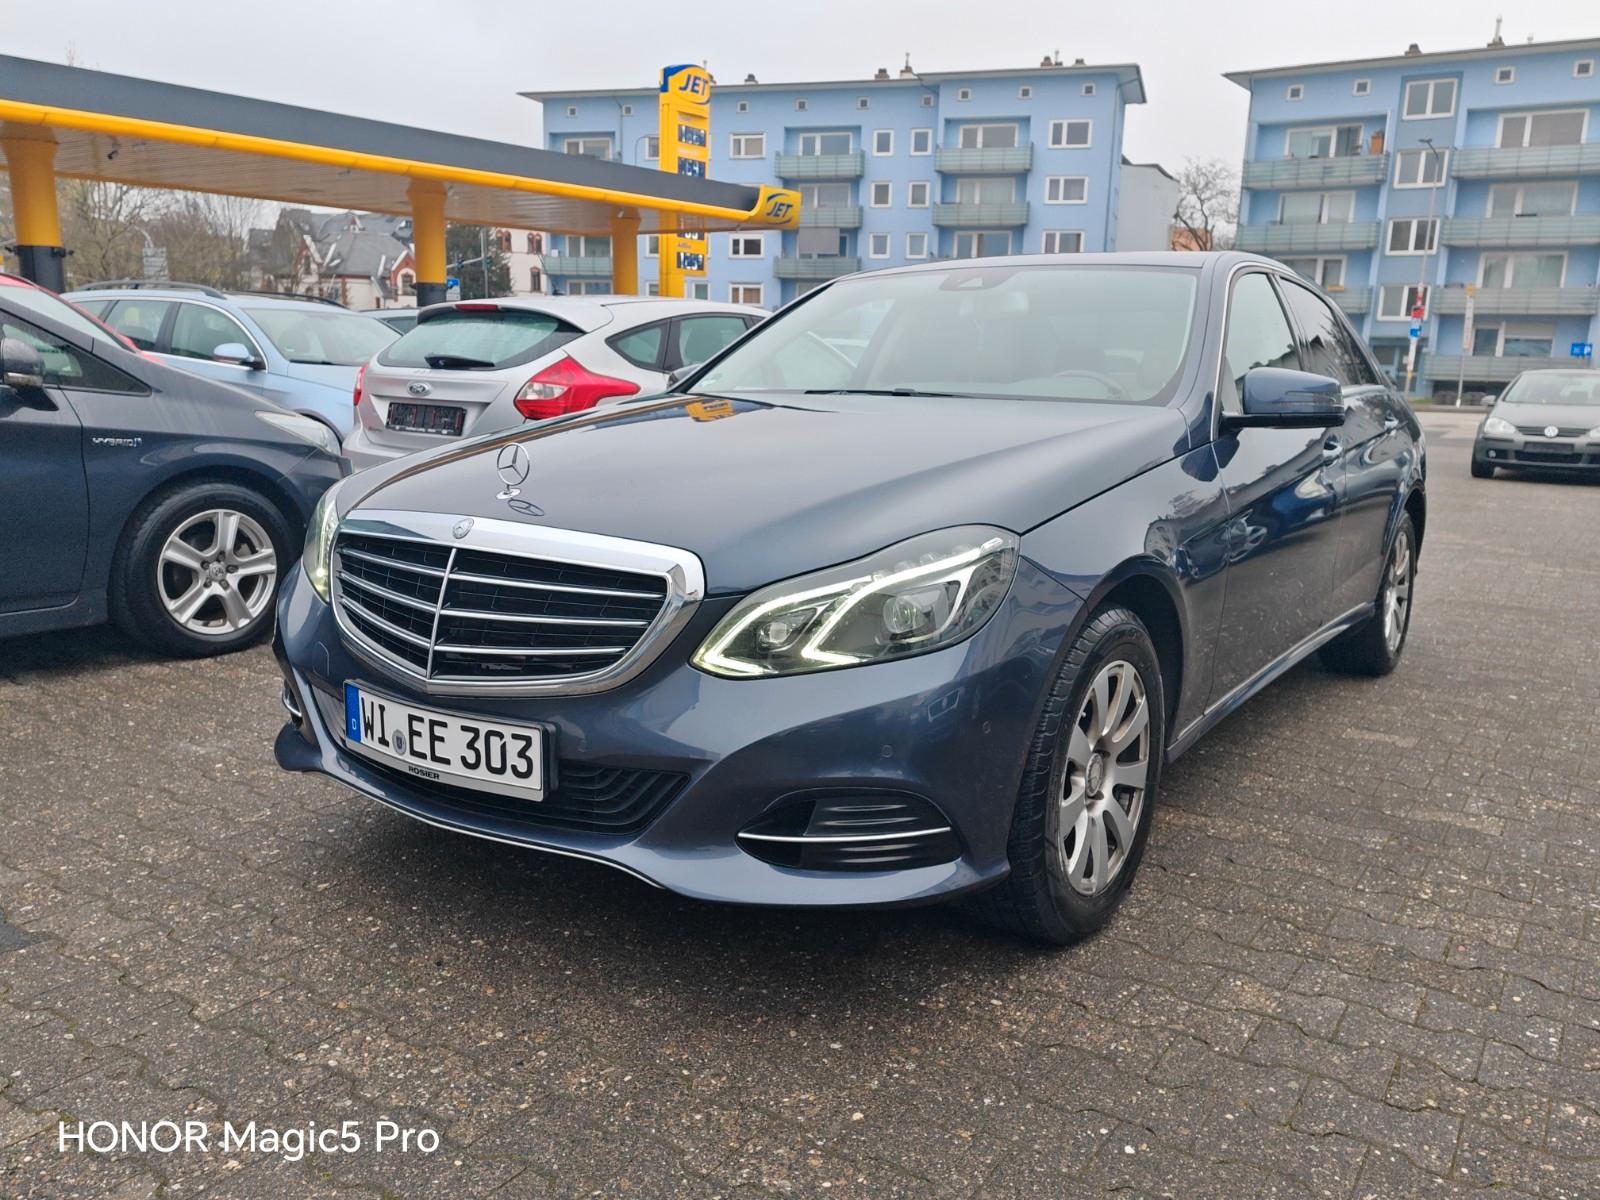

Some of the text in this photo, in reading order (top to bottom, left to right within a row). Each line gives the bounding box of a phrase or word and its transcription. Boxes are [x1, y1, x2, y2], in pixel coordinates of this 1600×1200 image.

[678, 74, 709, 96] JET
[766, 201, 794, 218] JET
[360, 697, 534, 780] WI EE 303
[408, 765, 440, 780] ROSIER
